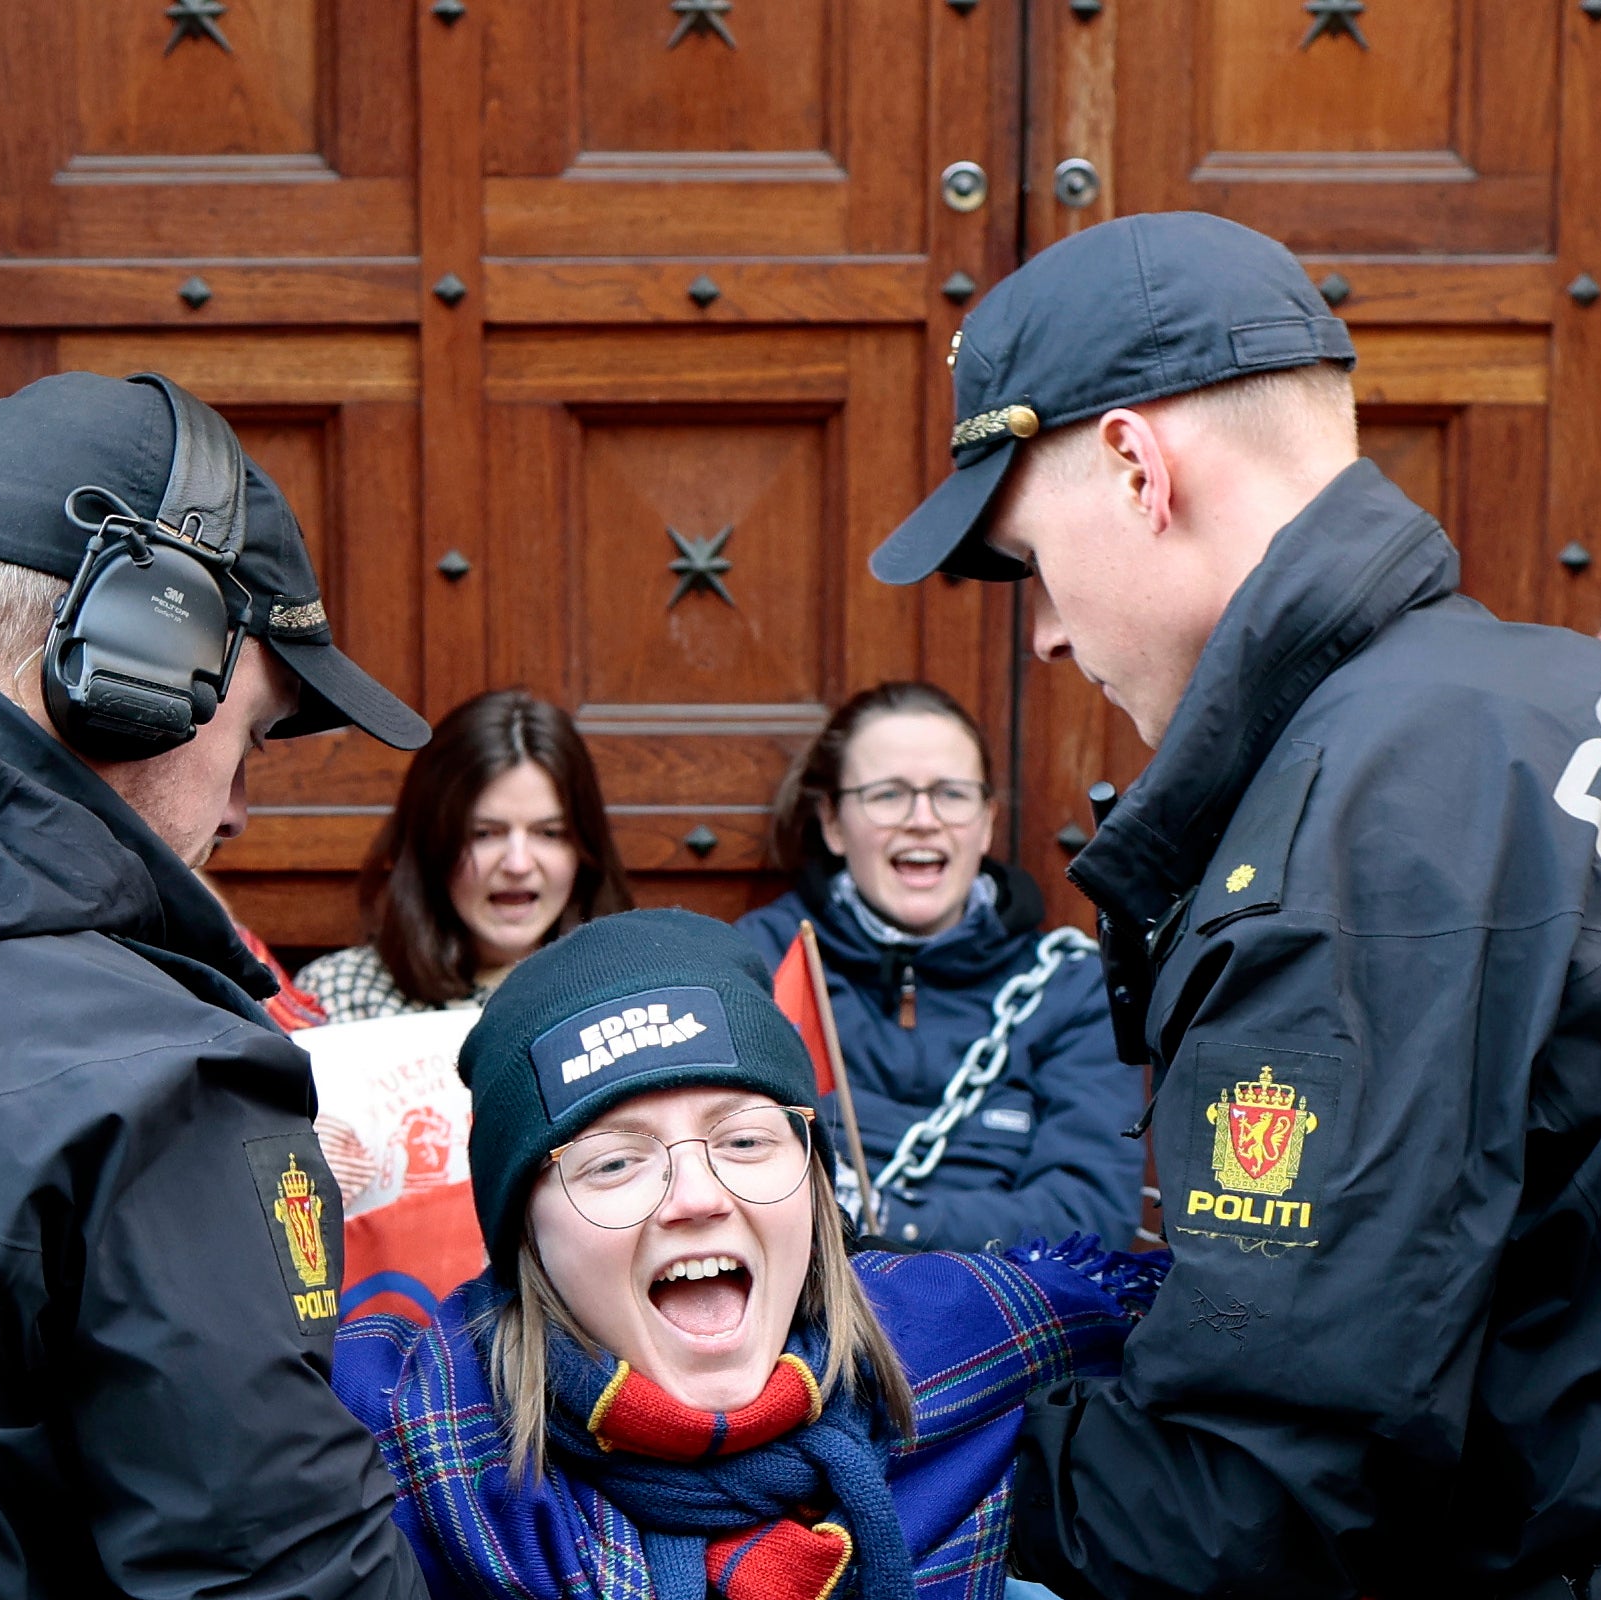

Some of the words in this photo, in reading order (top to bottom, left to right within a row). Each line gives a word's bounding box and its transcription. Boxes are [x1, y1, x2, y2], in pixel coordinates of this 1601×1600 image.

[164, 587, 184, 604] 3M
[579, 1004, 670, 1052] EDDE
[561, 1012, 708, 1084] MANNAK
[1187, 1190, 1311, 1228] POLITI
[293, 1289, 337, 1321] POLITI
